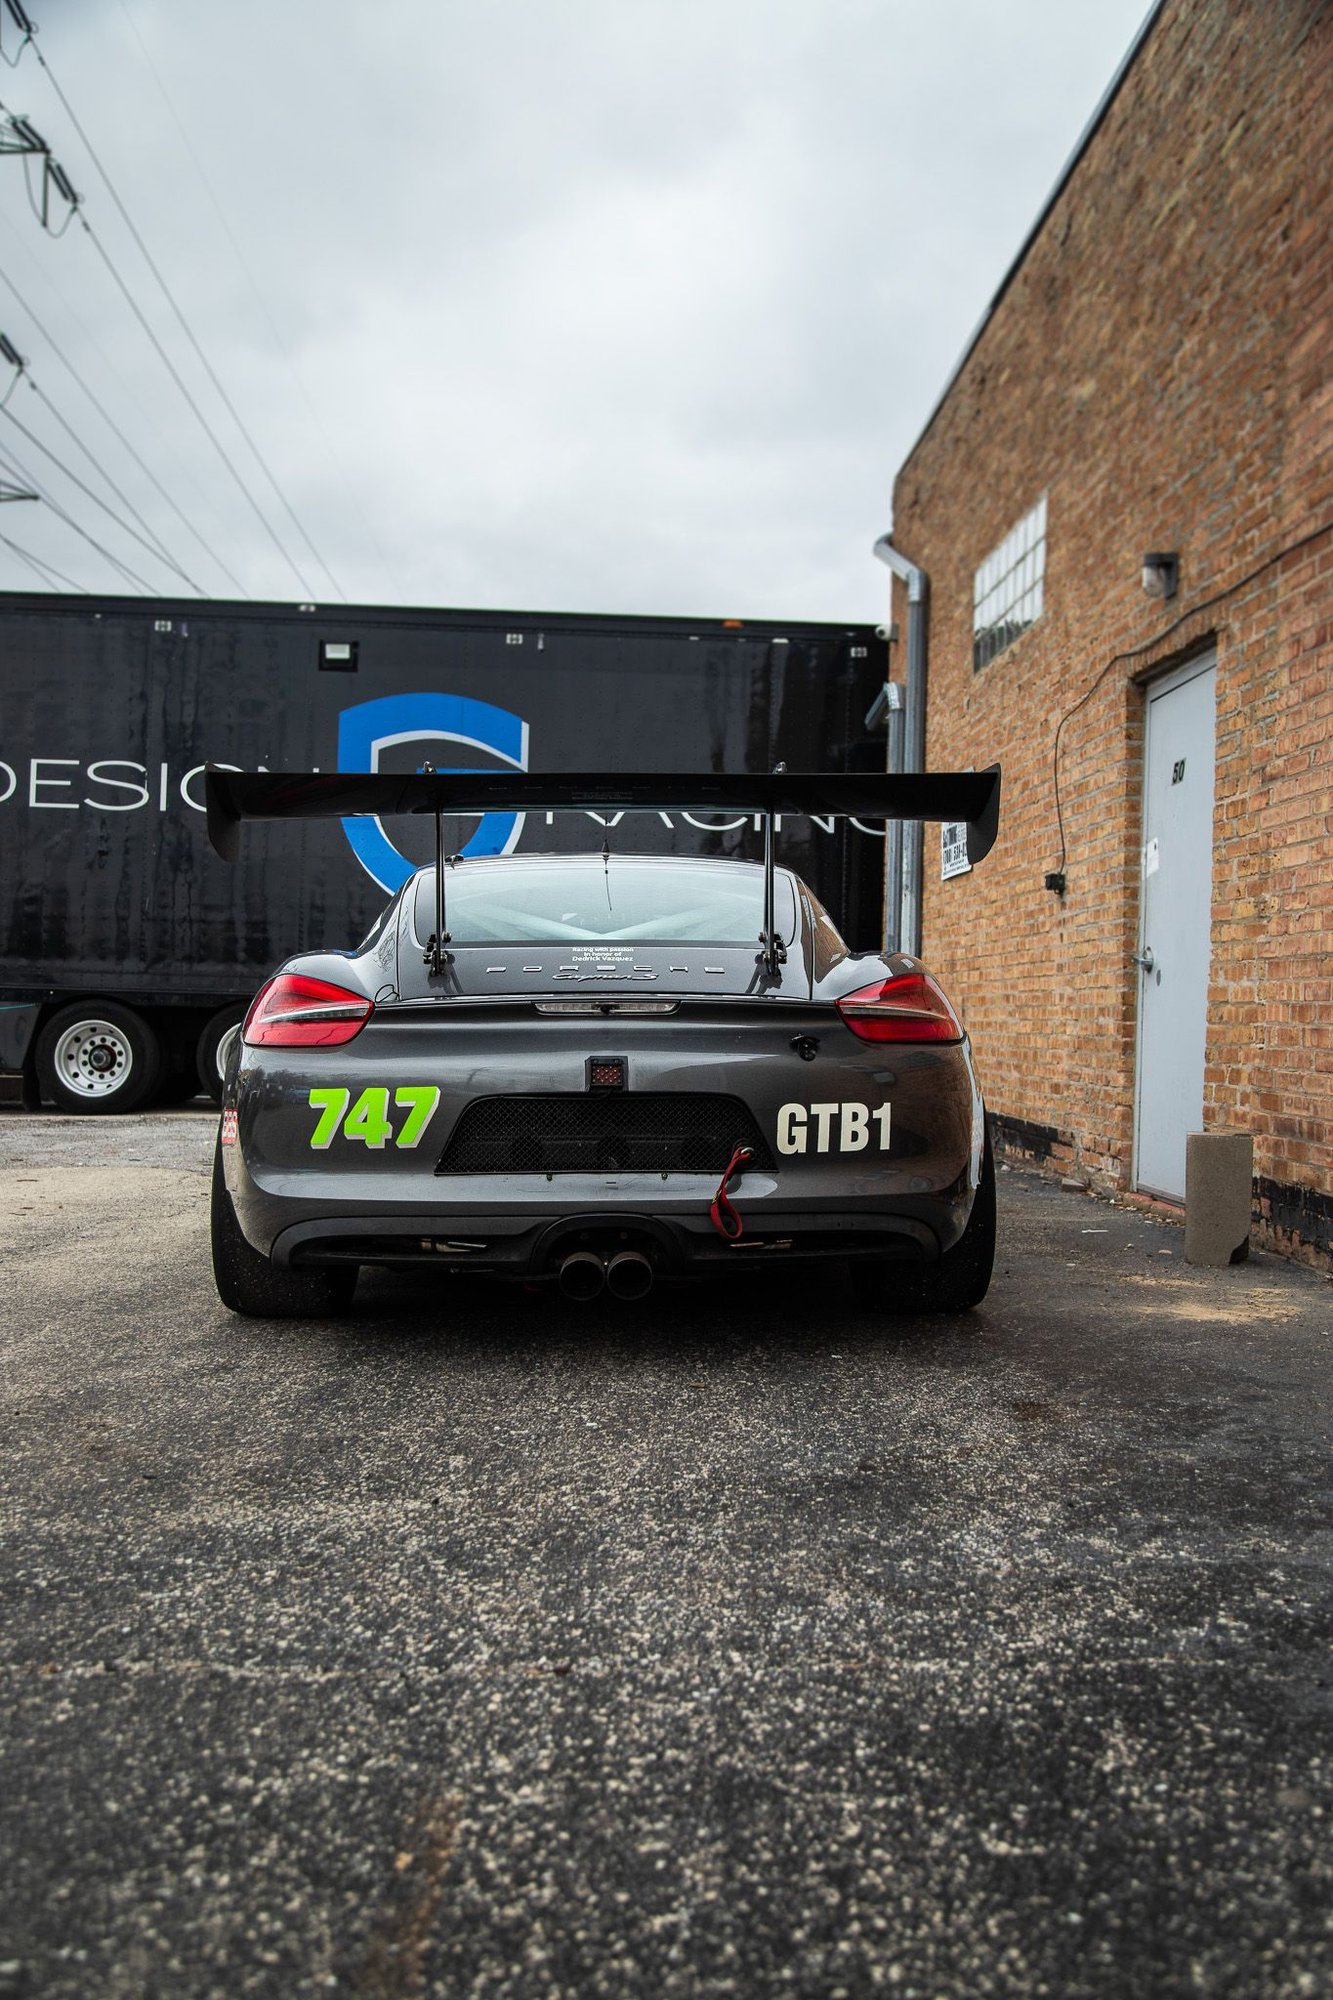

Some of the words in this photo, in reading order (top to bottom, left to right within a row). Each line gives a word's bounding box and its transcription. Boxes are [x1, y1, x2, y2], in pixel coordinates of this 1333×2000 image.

[1172, 759, 1186, 785] 50
[486, 965, 726, 974] PORSCHE
[309, 1086, 441, 1149] 747
[776, 1102, 892, 1155] GTB1
